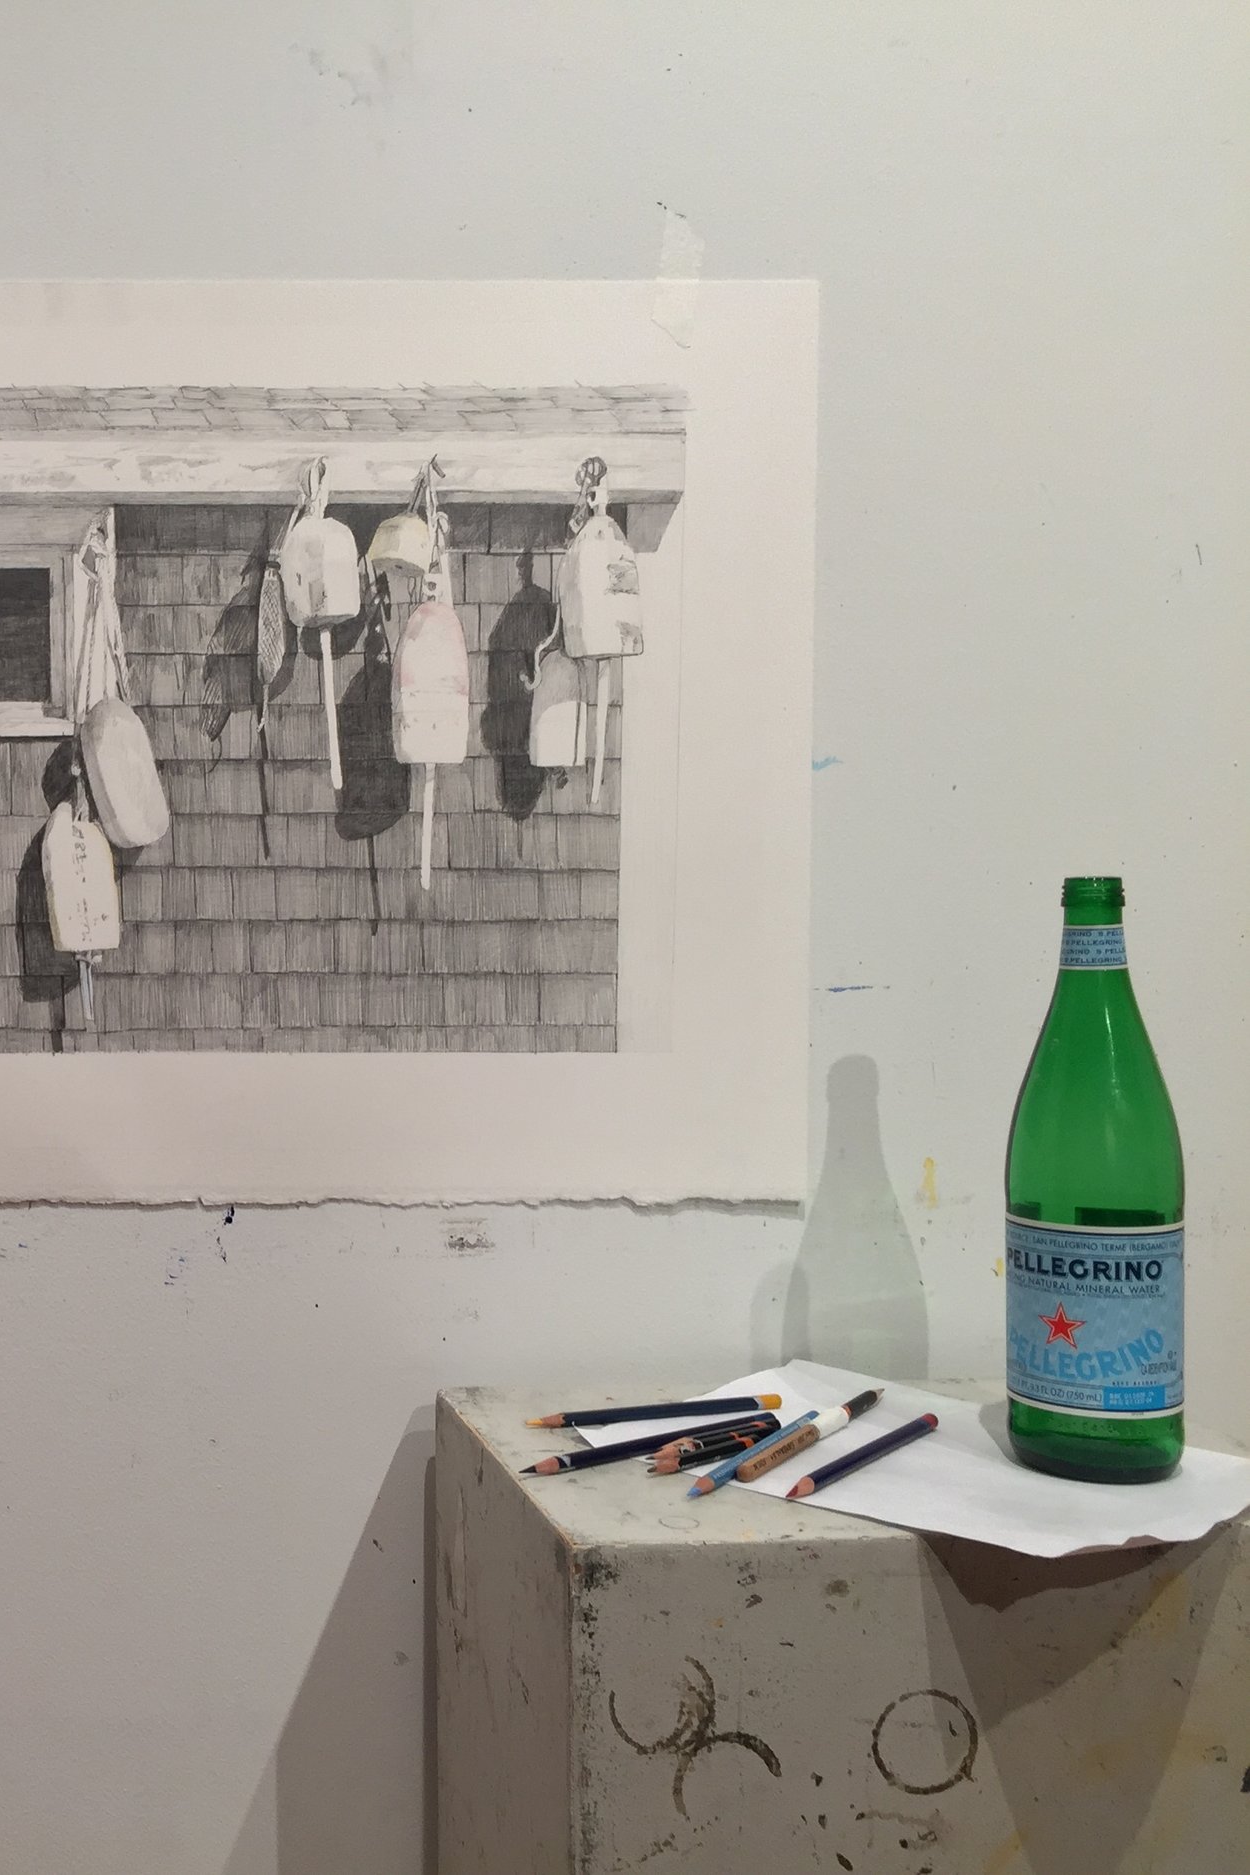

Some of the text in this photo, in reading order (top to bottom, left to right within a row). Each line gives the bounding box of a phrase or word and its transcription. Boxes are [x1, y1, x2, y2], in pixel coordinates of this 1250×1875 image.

[1049, 1239, 1098, 1251] PELLEGRINO
[1101, 1243, 1126, 1251] TERME
[1007, 1247, 1163, 1282] PELLEGRINO
[1028, 1276, 1070, 1291] NATURAL
[1075, 1284, 1124, 1295] MINERAL
[1128, 1284, 1160, 1294] WATER
[1009, 1326, 1164, 1382] PELLEGRINO
[1066, 1390, 1084, 1400] (750
[1086, 1393, 1103, 1402] mL)
